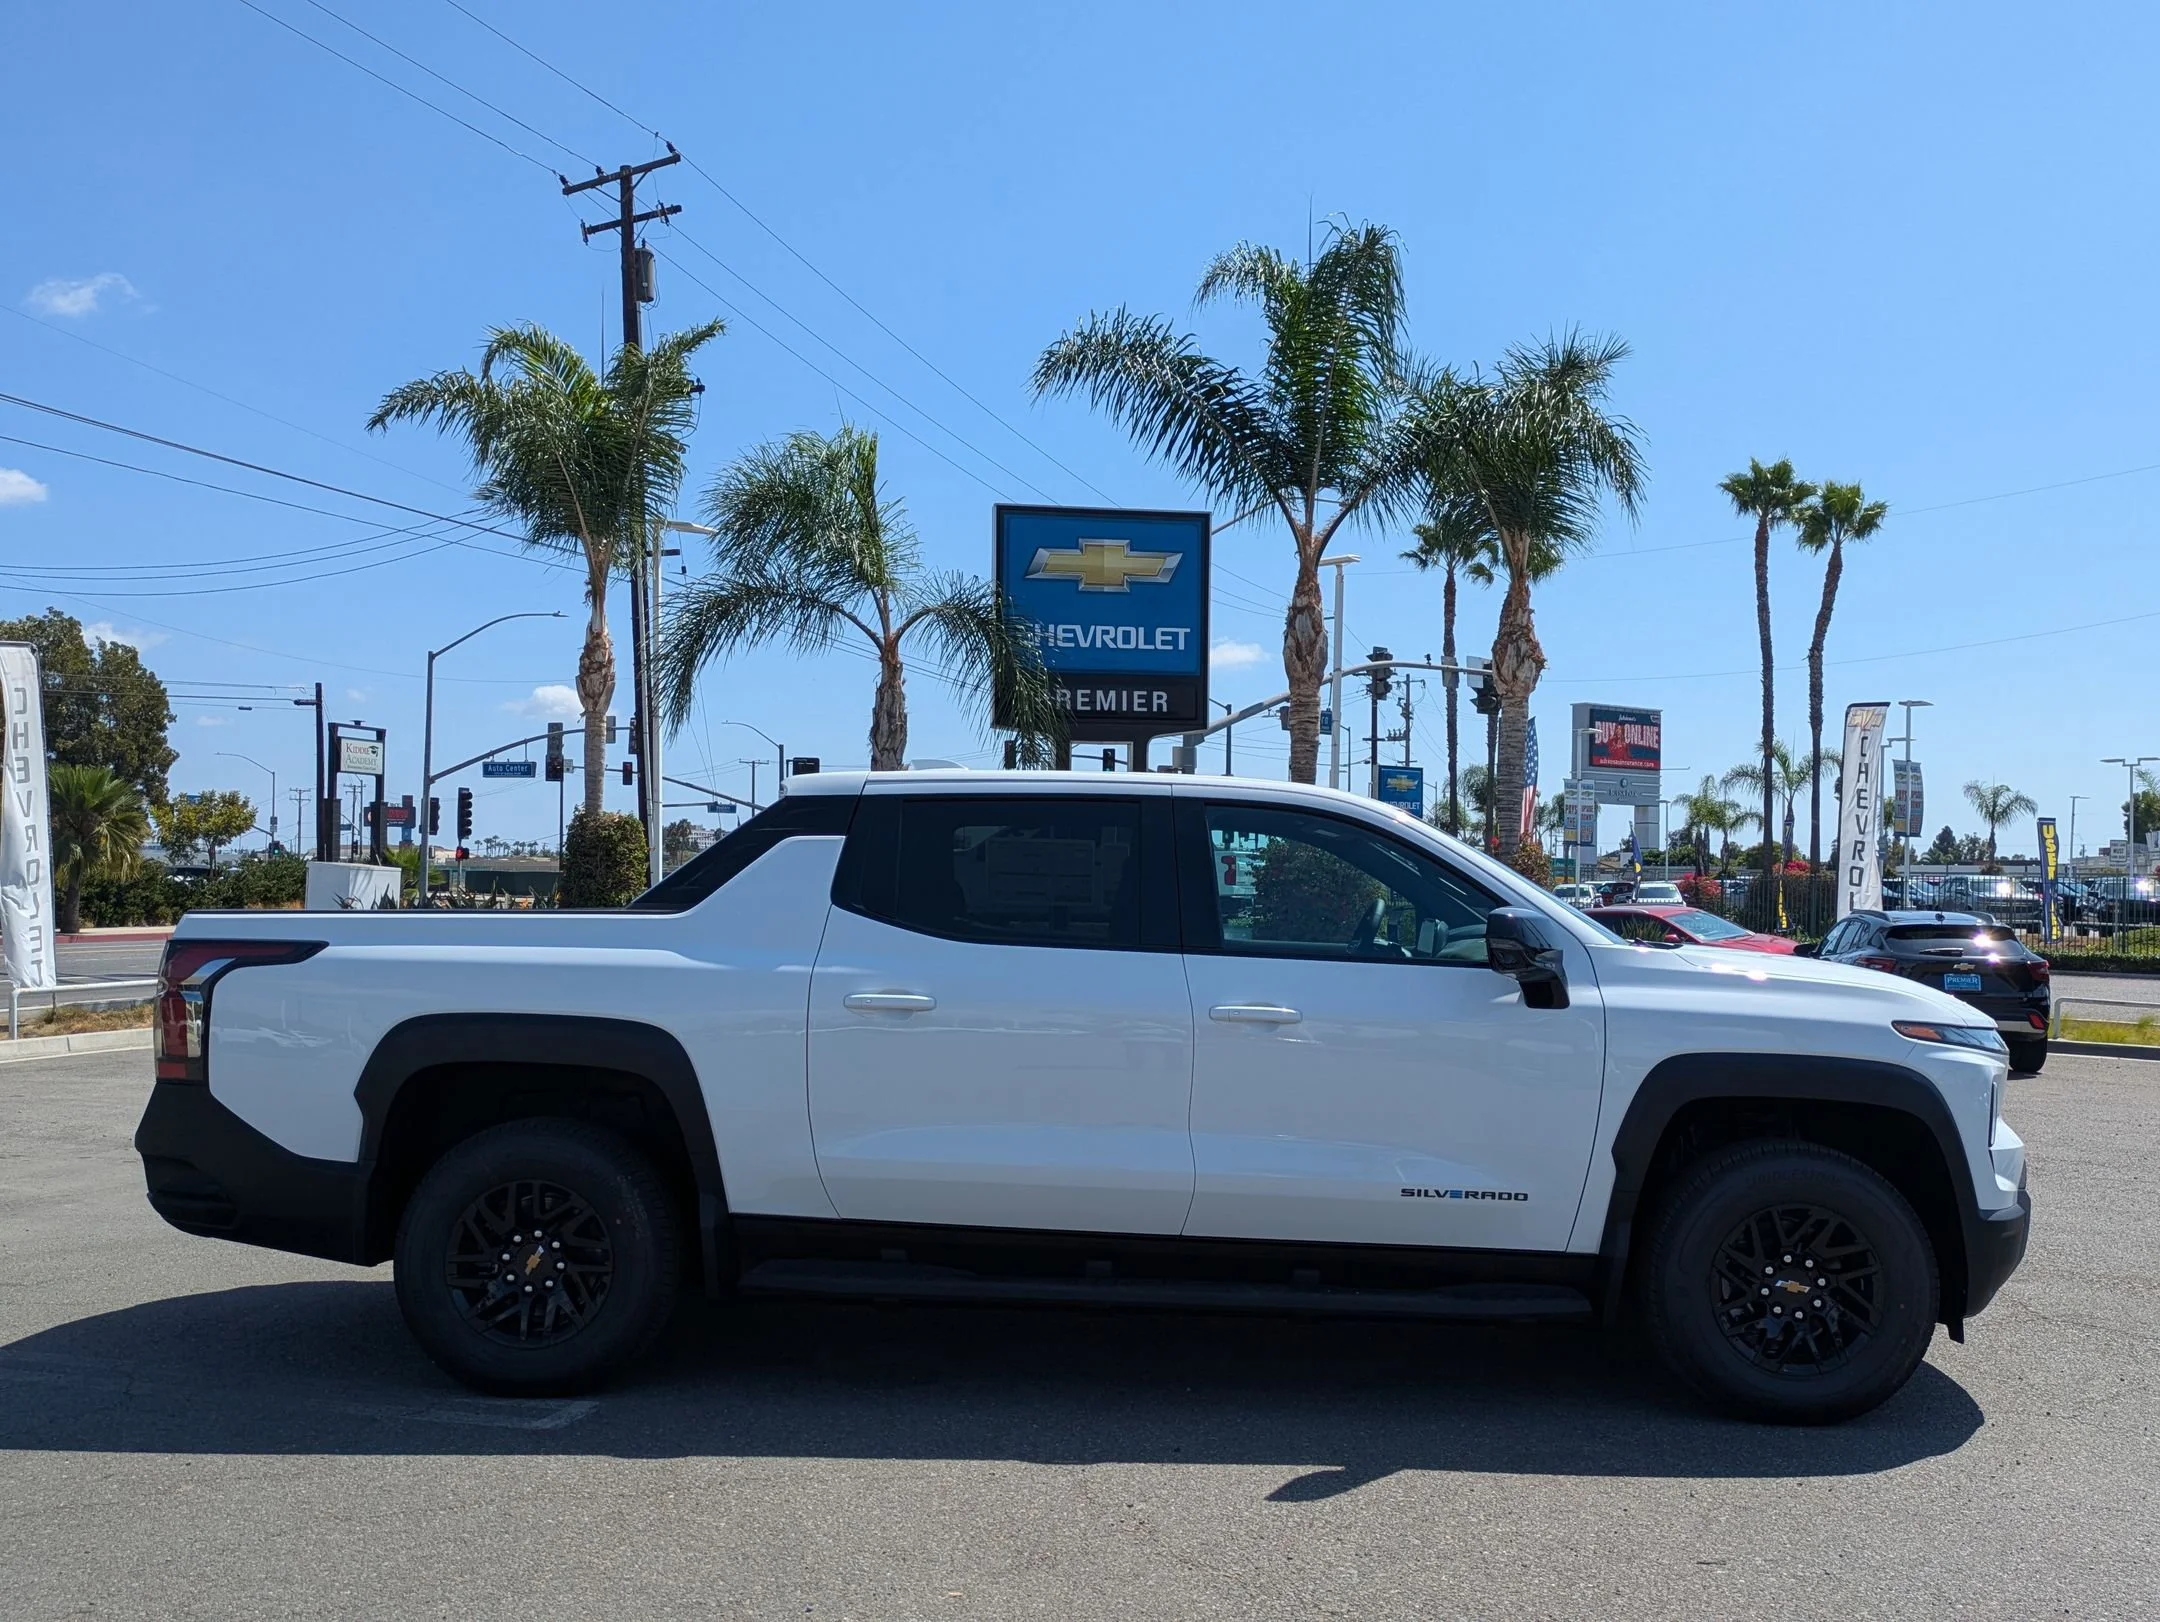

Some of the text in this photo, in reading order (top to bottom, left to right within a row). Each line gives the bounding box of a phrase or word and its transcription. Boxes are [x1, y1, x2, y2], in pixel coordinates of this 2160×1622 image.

[1028, 624, 1191, 650] HEVROLET
[1055, 688, 1168, 713] REMIER
[1595, 720, 1659, 749] BUY ONLINE
[488, 763, 528, 772] Auto Center
[1848, 735, 1869, 912] CHEVROL
[1947, 976, 1978, 985] PREMIER
[1400, 1188, 1529, 1202] SILVERADO
